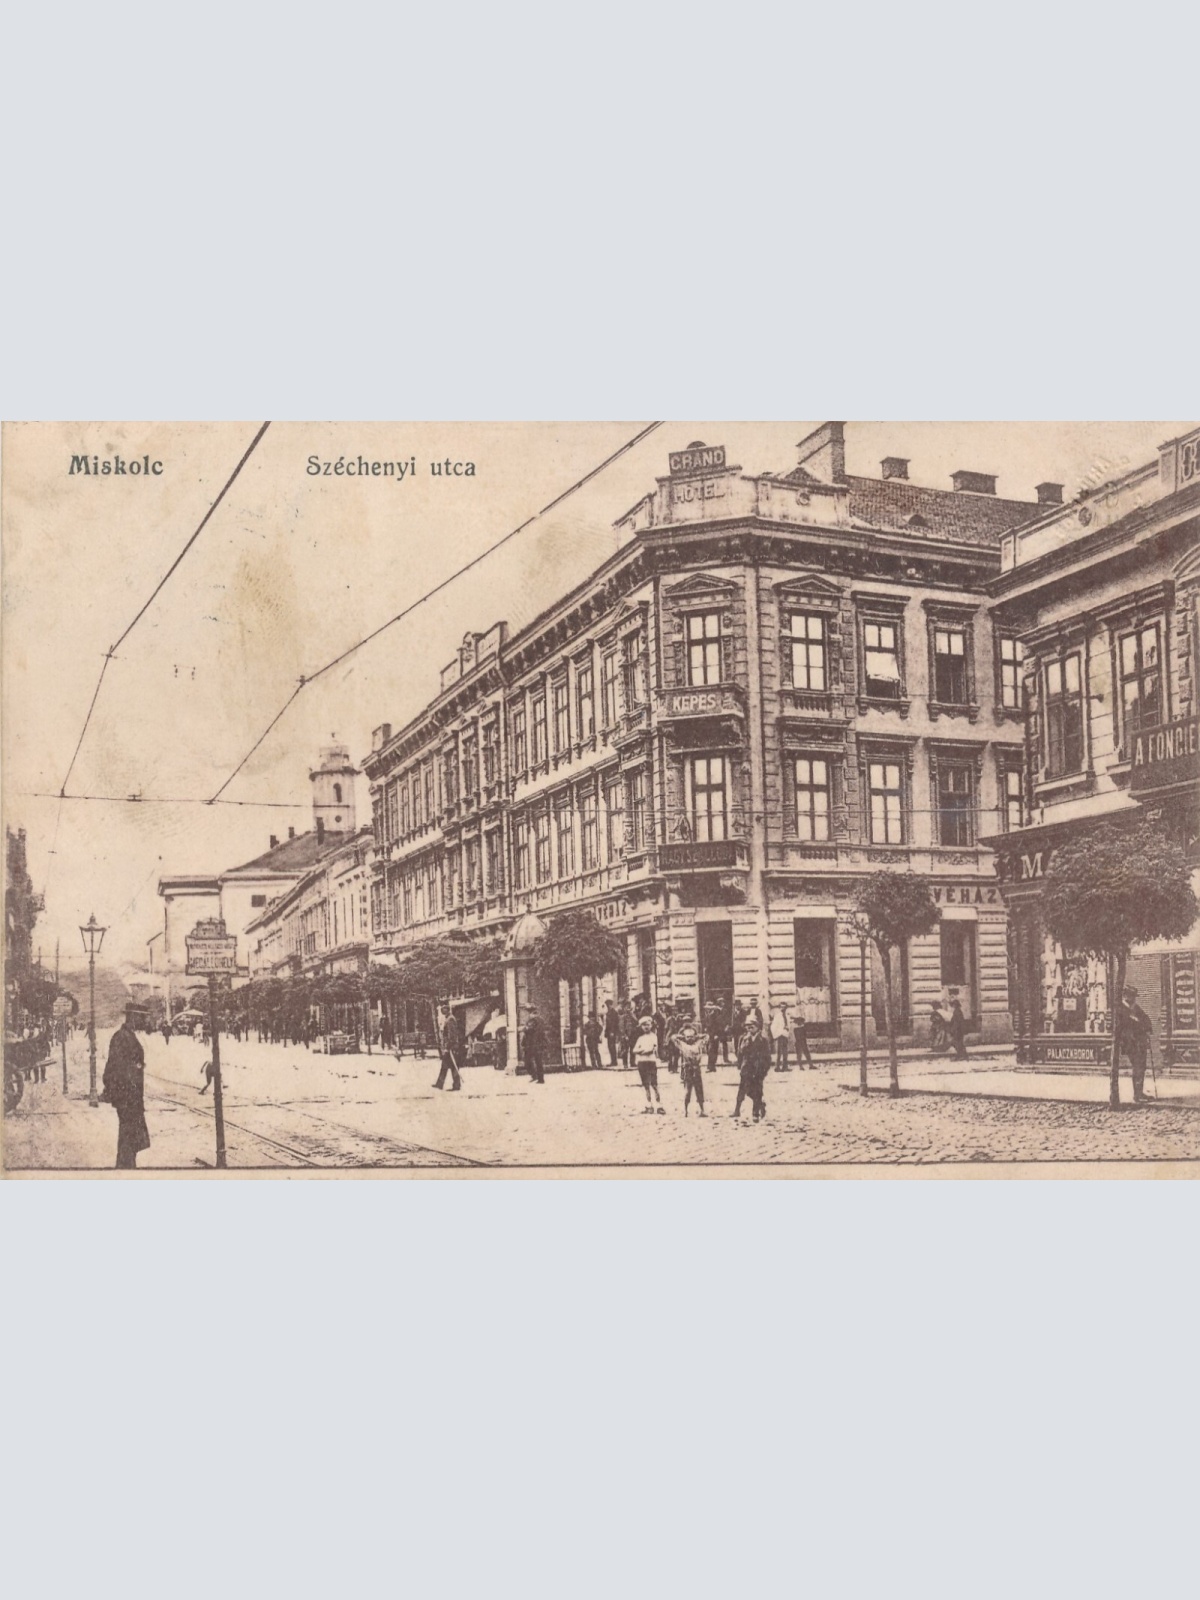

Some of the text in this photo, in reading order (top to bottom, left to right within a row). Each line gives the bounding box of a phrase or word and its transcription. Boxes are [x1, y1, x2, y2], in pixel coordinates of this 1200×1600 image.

[670, 450, 724, 470] GRAND
[1135, 723, 1197, 765] A FONCIE
